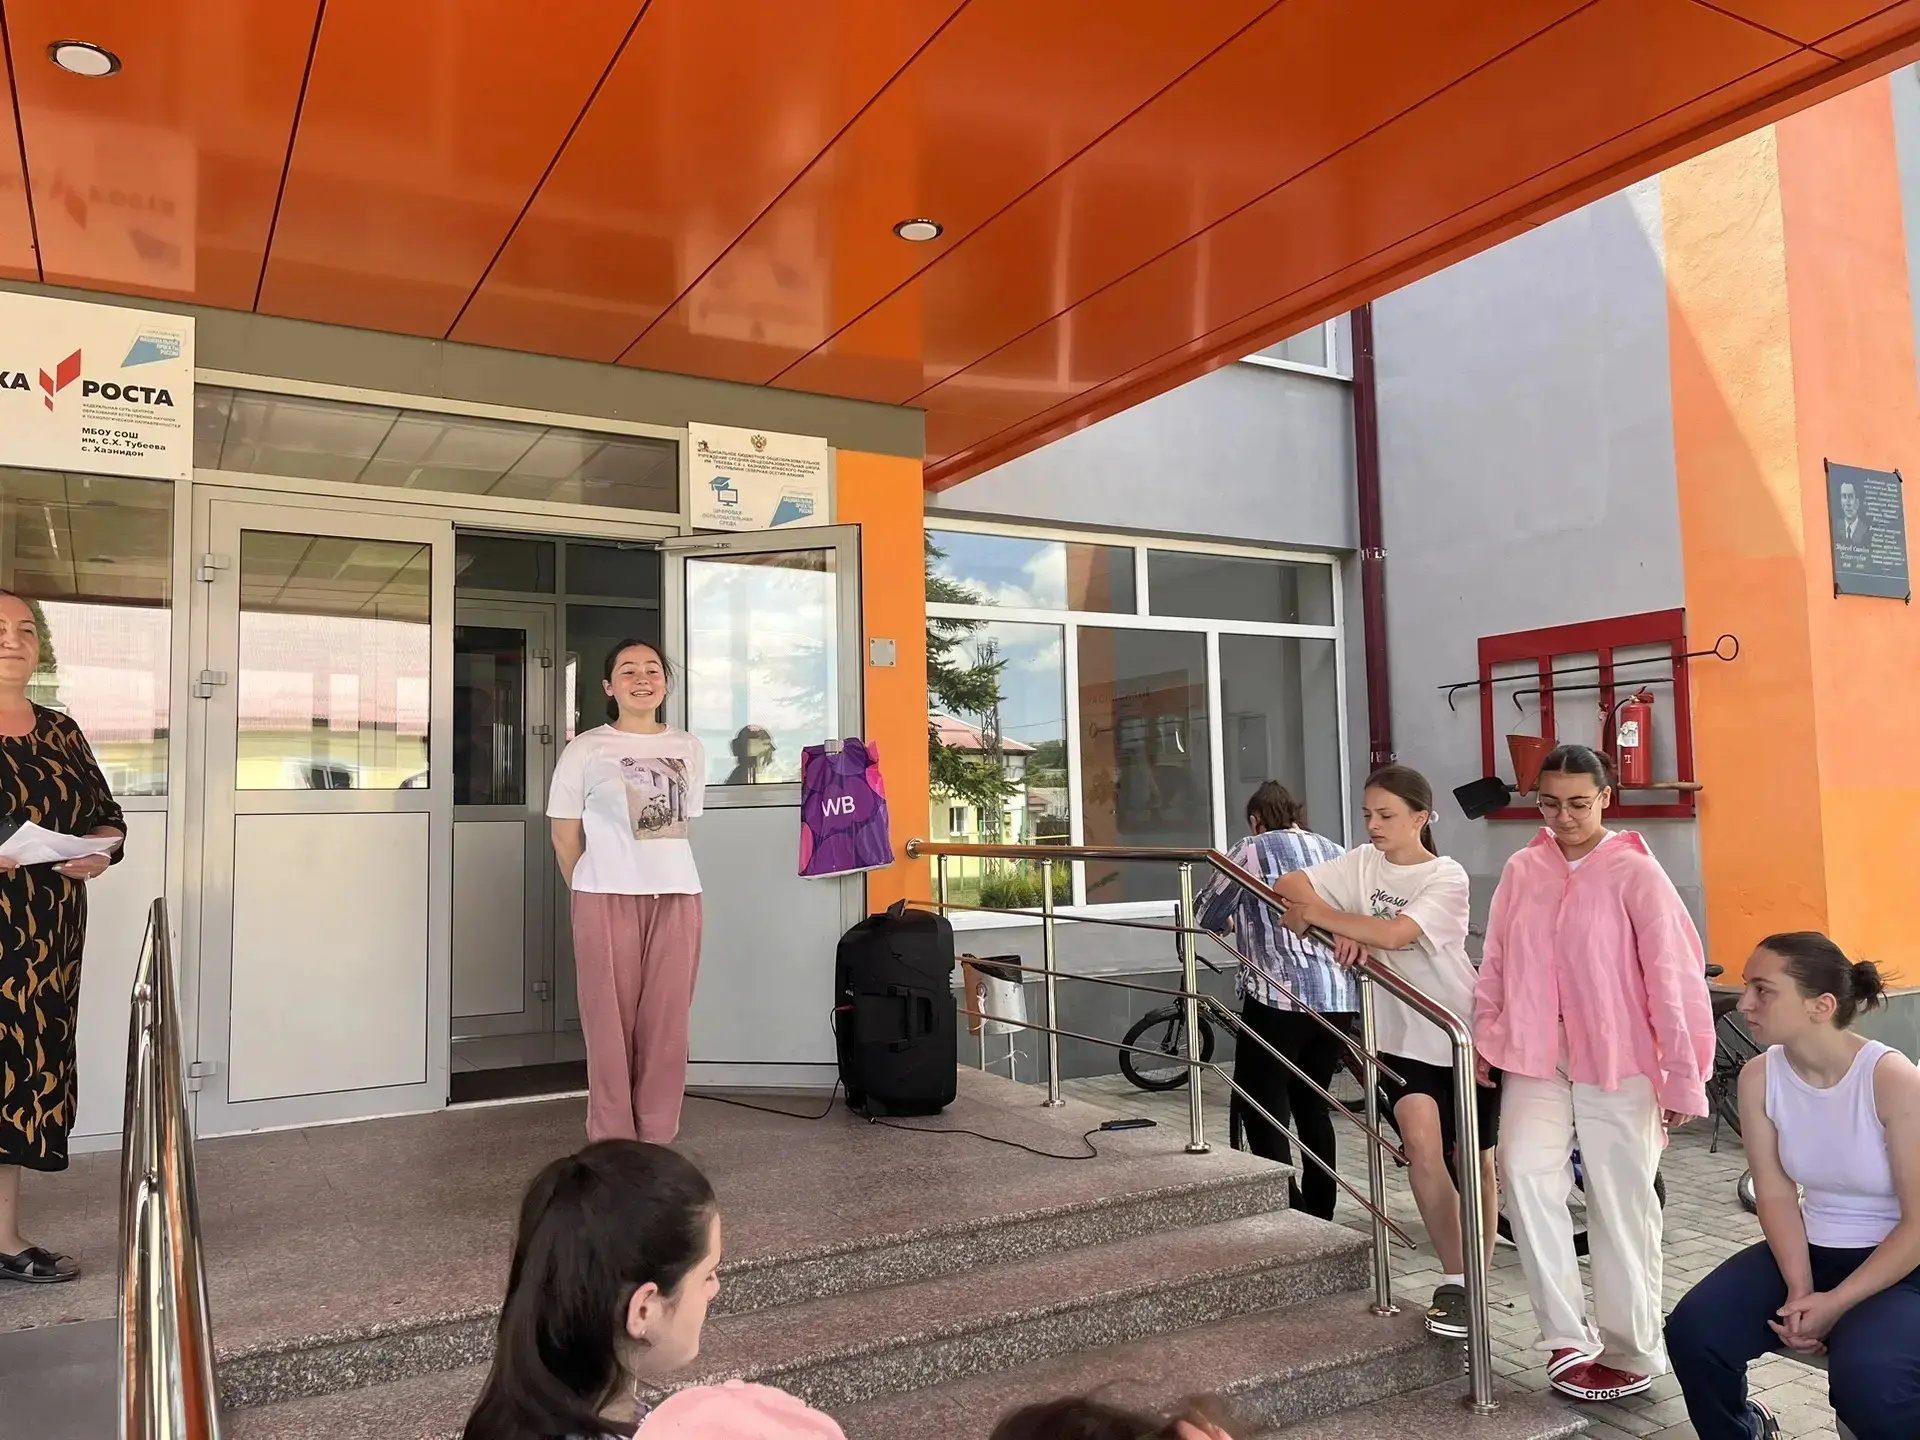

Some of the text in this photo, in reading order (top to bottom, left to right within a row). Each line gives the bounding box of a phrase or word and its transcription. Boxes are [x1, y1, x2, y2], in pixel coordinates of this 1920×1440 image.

[82, 380, 174, 407] РОСТА
[82, 428, 139, 439] МБОУ СОШ
[102, 438, 122, 446] С.Х.
[125, 440, 166, 451] Тубеева
[94, 446, 144, 457] Хазнидон
[822, 796, 856, 817] WB
[1585, 1389, 1620, 1399] crocs
